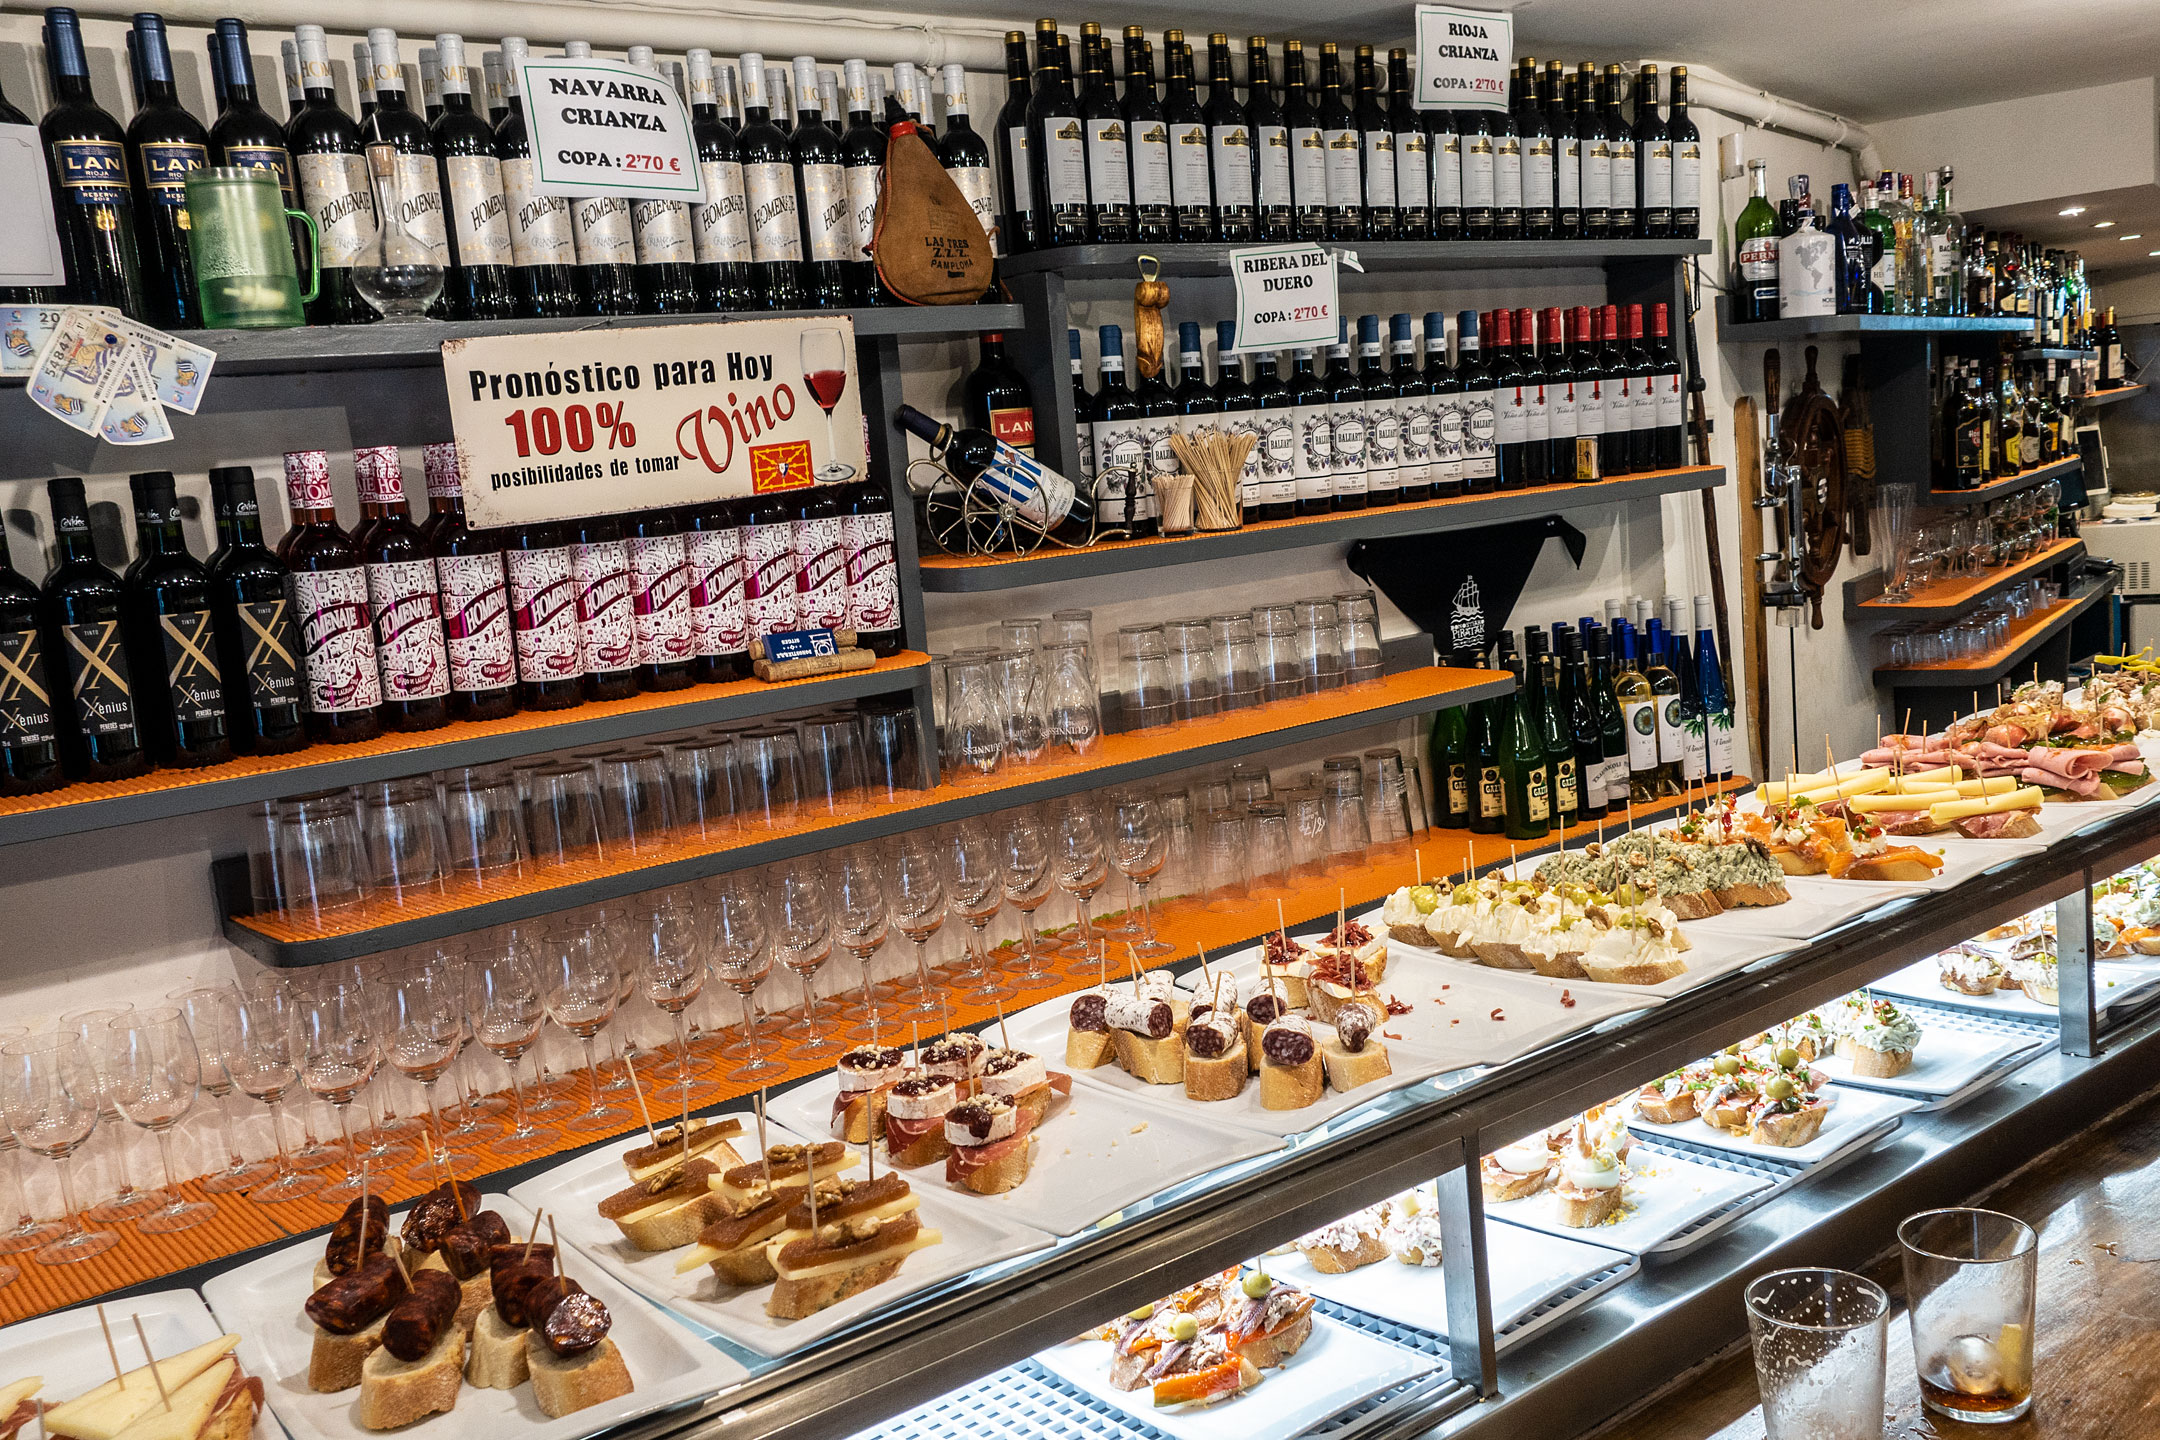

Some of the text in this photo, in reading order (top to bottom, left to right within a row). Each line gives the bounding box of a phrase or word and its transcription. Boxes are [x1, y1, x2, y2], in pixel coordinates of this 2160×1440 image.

[1448, 22, 1488, 39] RIOJA
[1438, 45, 1499, 61] CRIANZA
[549, 78, 667, 106] NAVARRA
[1433, 77, 1467, 90] COPA
[560, 107, 667, 133] CRIANZA
[67, 157, 121, 171] LAN
[152, 158, 202, 172] LAN
[558, 151, 612, 168] COPA
[320, 191, 371, 233] HOMENAJE
[402, 191, 441, 224] OMENAJE
[519, 196, 566, 233] HOMENAJE
[581, 196, 627, 233] HOMENAJE
[636, 199, 682, 234] HOMENAJE
[702, 194, 744, 232] HOMENAJE
[753, 195, 795, 232] HOMENAJE
[925, 236, 969, 249] LAS TRES
[1243, 252, 1327, 273] RIBERA DEL
[1262, 274, 1313, 292] DUERO
[1253, 311, 1286, 324] COPA
[45, 331, 74, 379] 54847
[468, 352, 774, 402] Pronóstico para Hoy
[505, 399, 637, 458] 100%
[675, 382, 796, 474] Vino
[1000, 421, 1033, 434] LAN
[490, 454, 680, 491] posibilidades de tomar
[303, 606, 358, 653] HOMENAJE
[380, 596, 433, 643] HOMENAJE
[1452, 624, 1485, 640] PIRATAK
[84, 629, 99, 637] TINTO
[176, 683, 221, 708] Xenius
[252, 671, 295, 696] Xenius
[1, 707, 50, 734] Xenius
[80, 696, 128, 722] Xenius
[1048, 725, 1089, 737] GUINNESS
[962, 741, 1004, 755] GUINNESS
